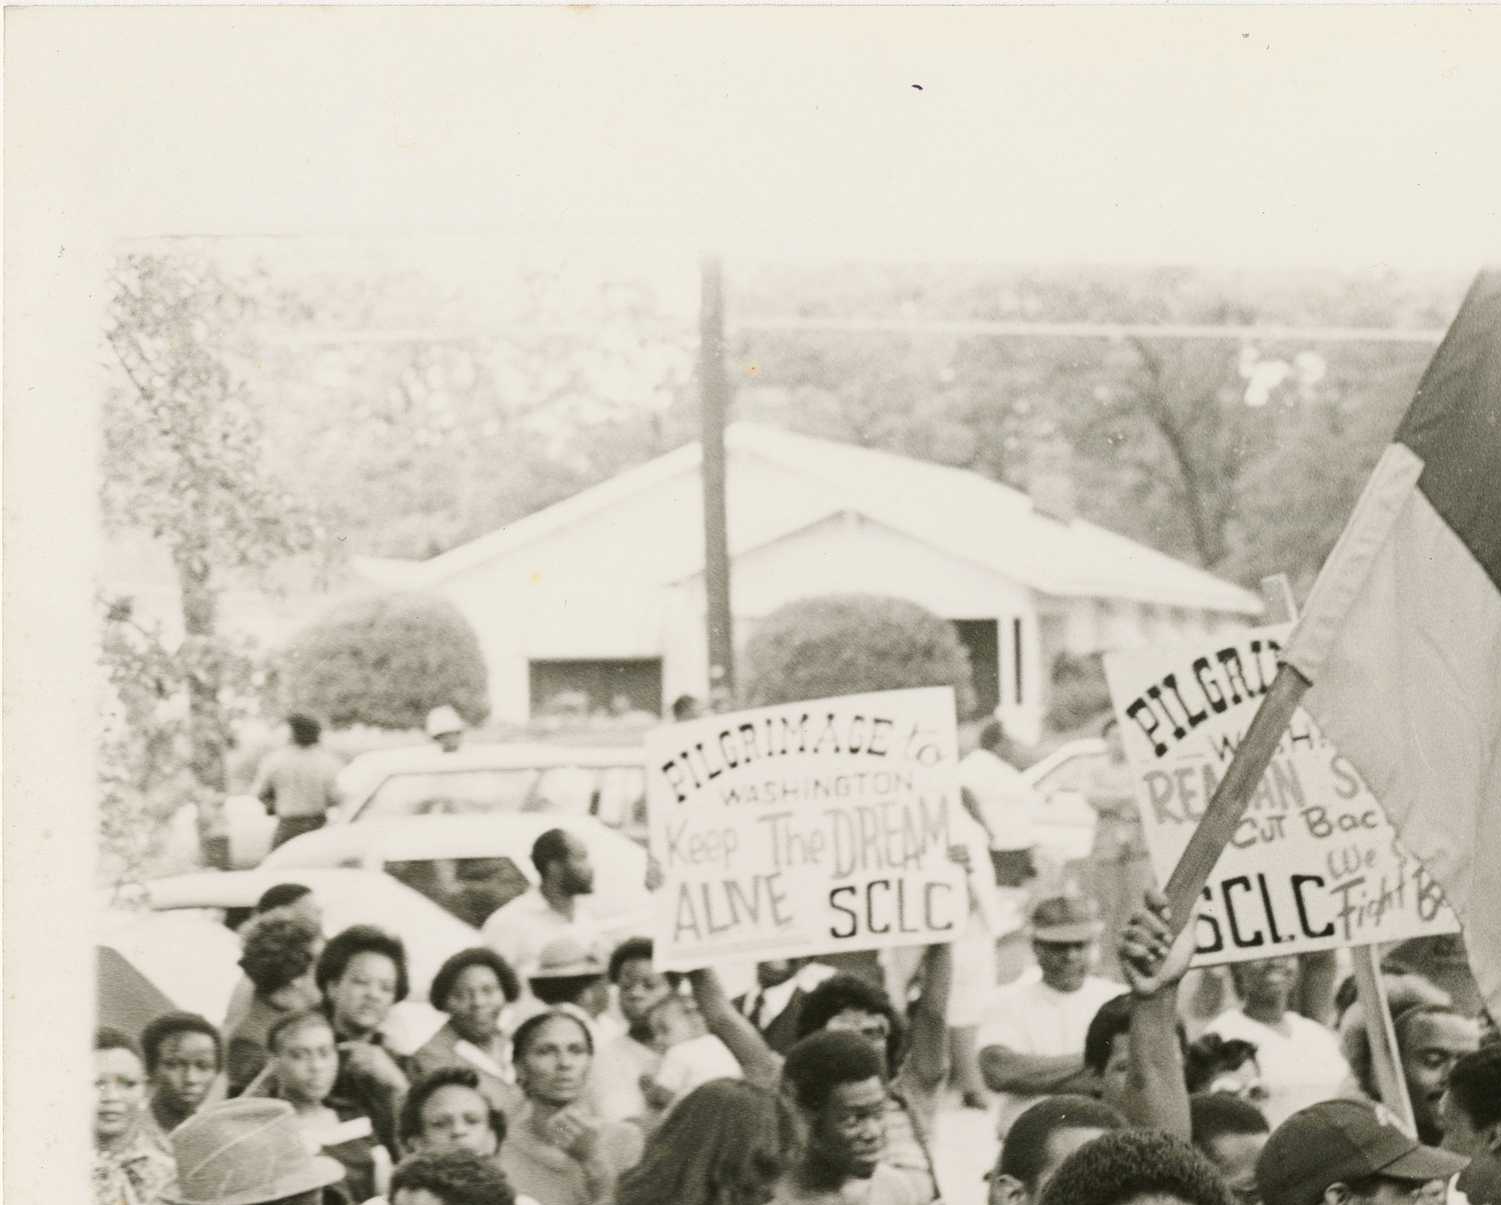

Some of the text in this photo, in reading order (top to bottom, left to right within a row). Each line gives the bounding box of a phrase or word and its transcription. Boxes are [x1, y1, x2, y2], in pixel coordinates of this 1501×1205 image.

[1125, 638, 1282, 758] PILGRI
[661, 712, 943, 803] PILGRIMAGE to
[722, 770, 913, 807] WASHINGTON
[664, 795, 950, 880] Keep The DREAM
[673, 872, 954, 943] ALIVE SCLC
